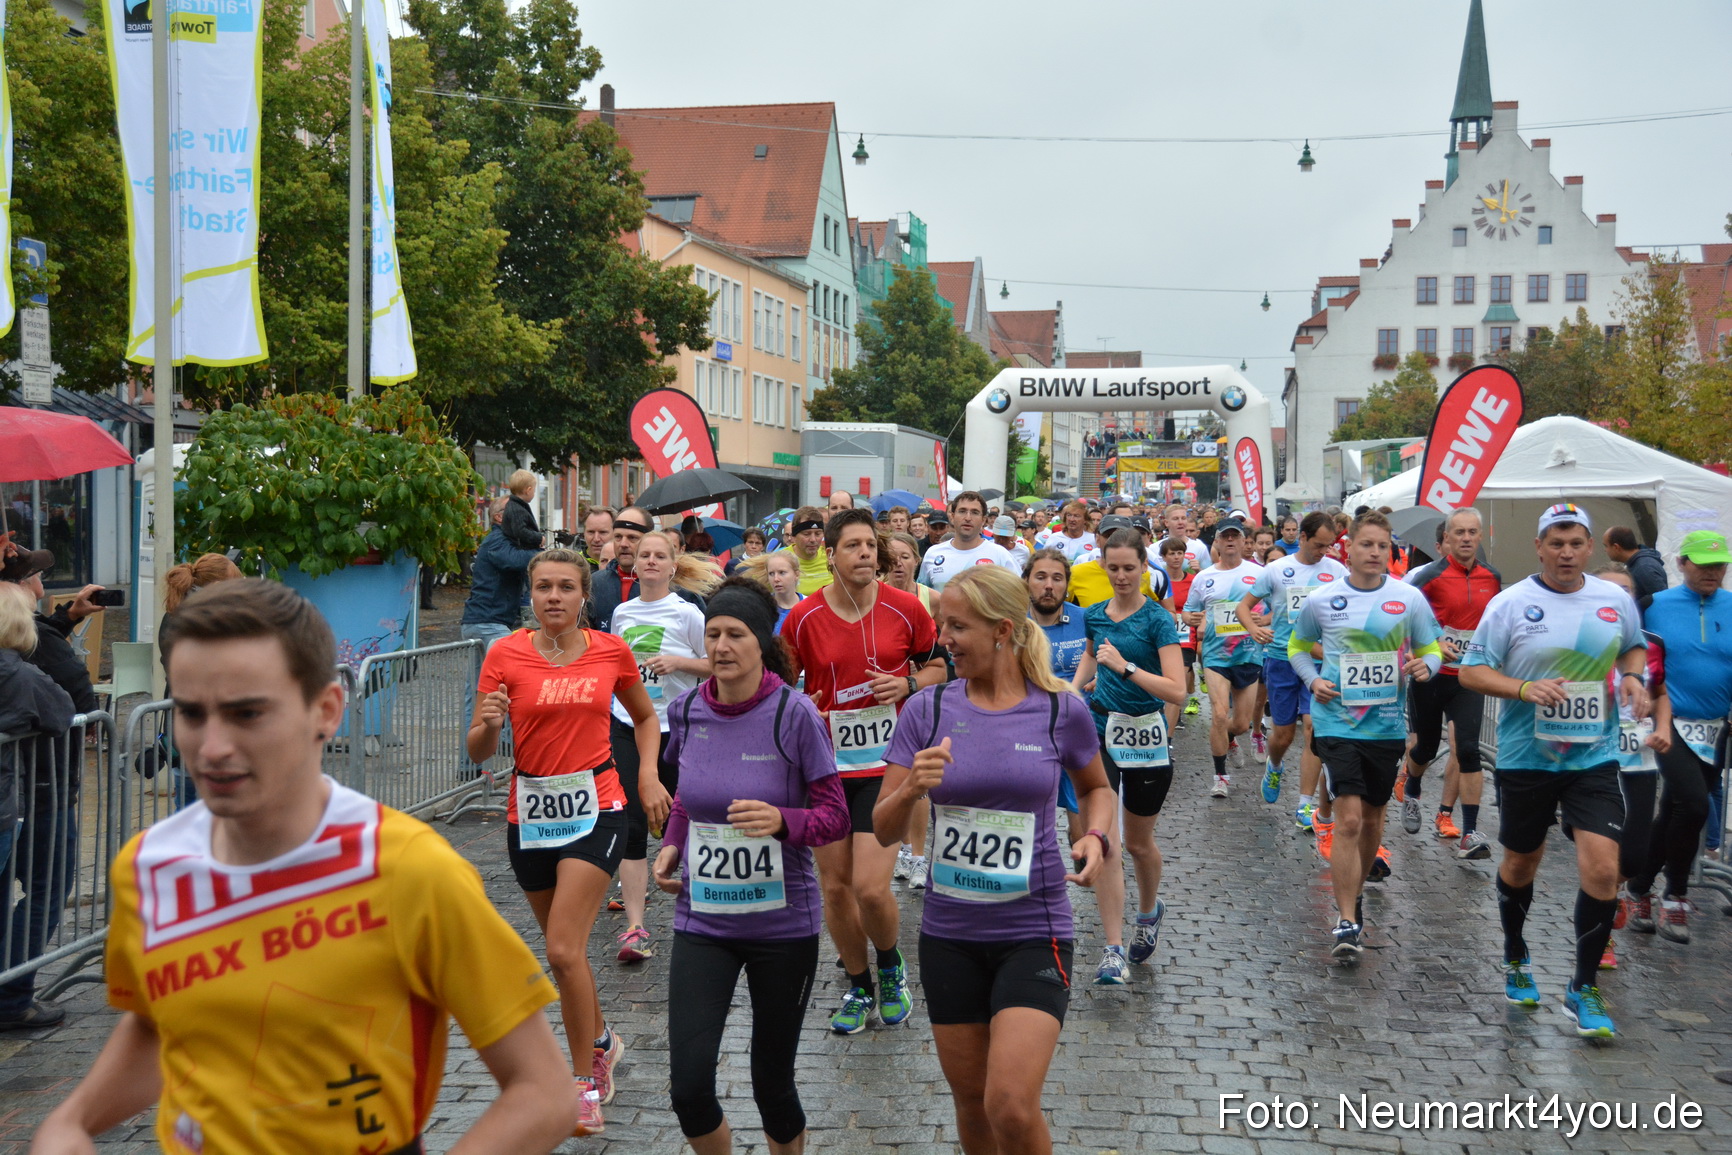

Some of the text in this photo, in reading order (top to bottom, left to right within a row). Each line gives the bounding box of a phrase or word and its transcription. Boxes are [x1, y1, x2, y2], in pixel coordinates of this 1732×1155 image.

[1020, 376, 1211, 400] BMW Laufsport
[1426, 387, 1509, 515] REWE
[1157, 460, 1180, 470] ZIEL
[1239, 446, 1260, 507] REWE
[1347, 665, 1394, 685] 2452
[536, 677, 598, 706] NIKE
[847, 687, 865, 698] DEHN
[1362, 690, 1381, 698] Timo
[838, 719, 893, 747] 2012
[1112, 725, 1163, 746] 2389
[741, 752, 778, 761] Bernadette
[1014, 742, 1042, 752] Kristina
[1119, 750, 1155, 760] Veronika
[526, 790, 592, 819] 2802
[976, 812, 1024, 827] BOCK
[942, 826, 1023, 869] 2426
[698, 844, 773, 880] 2204
[954, 871, 1002, 891] Kristina
[145, 899, 388, 1001] MAX BÖGL
